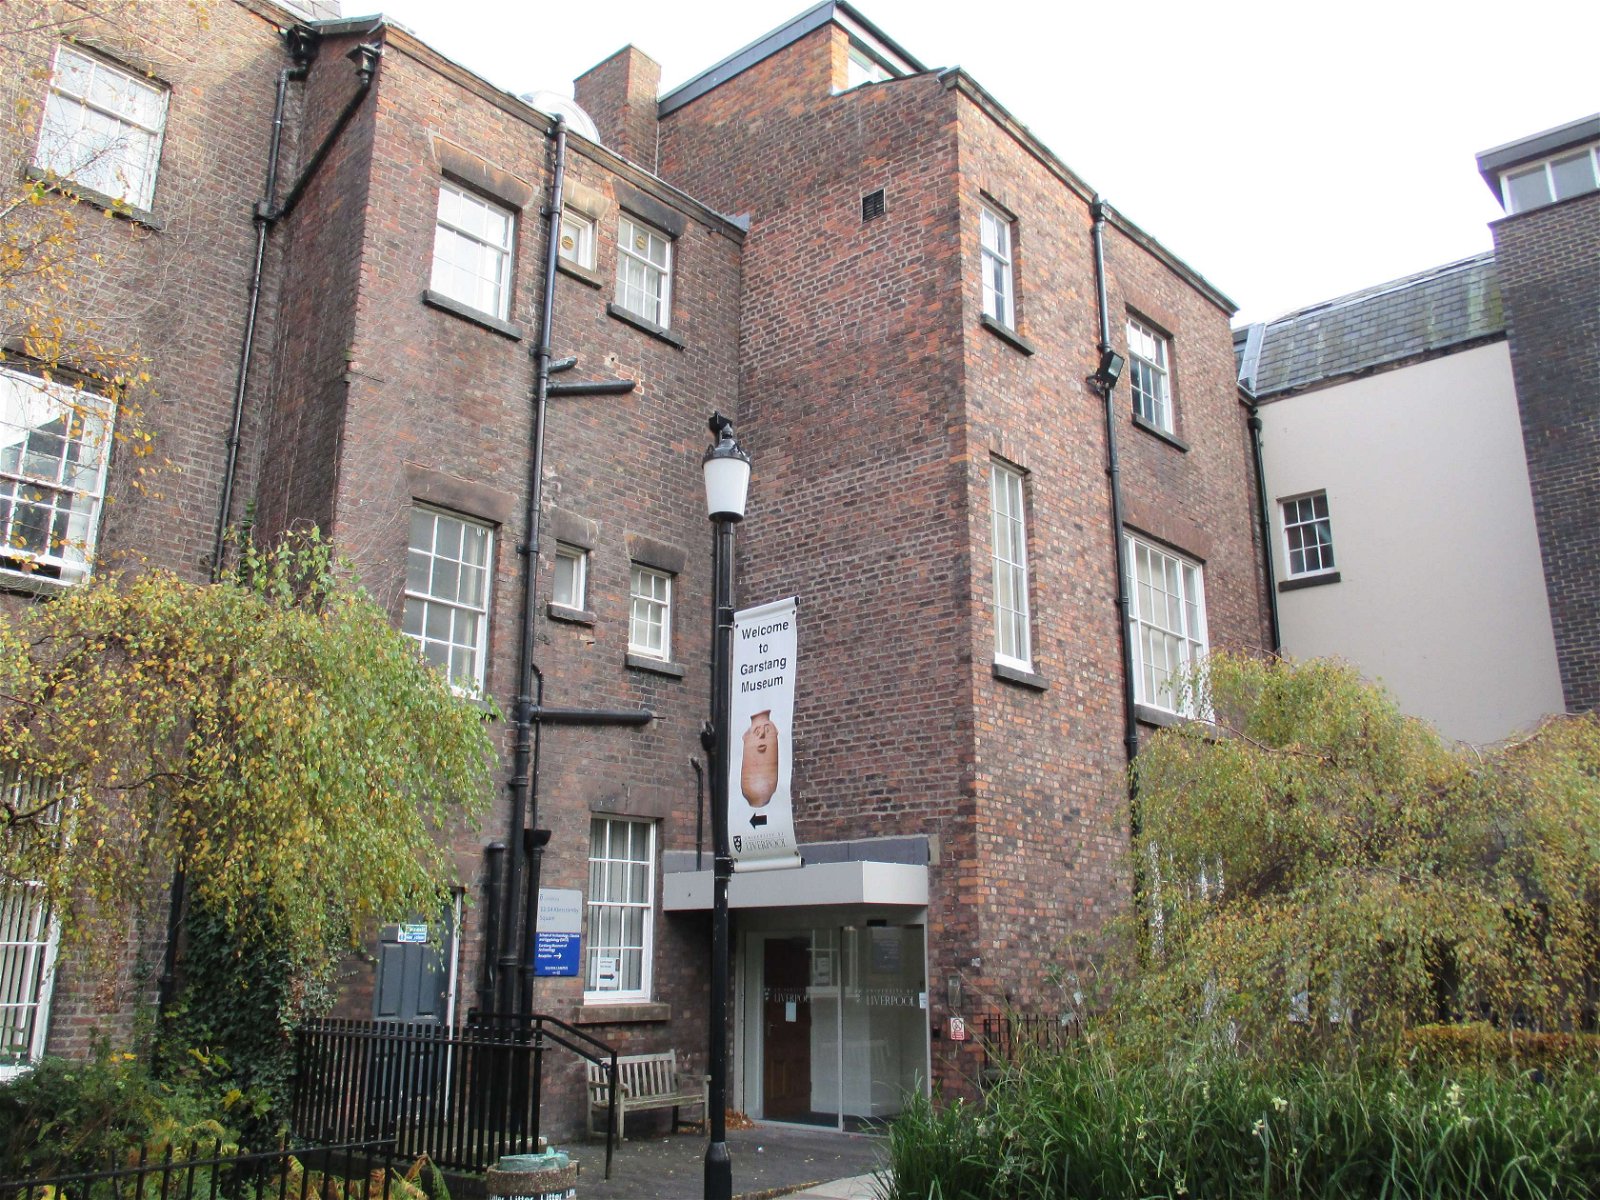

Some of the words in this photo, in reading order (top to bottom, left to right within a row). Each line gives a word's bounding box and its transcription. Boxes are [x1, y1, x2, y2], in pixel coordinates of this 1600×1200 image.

[741, 621, 789, 640] Welcome
[759, 643, 769, 654] to
[740, 657, 787, 675] Garstang
[741, 676, 783, 693] Museum
